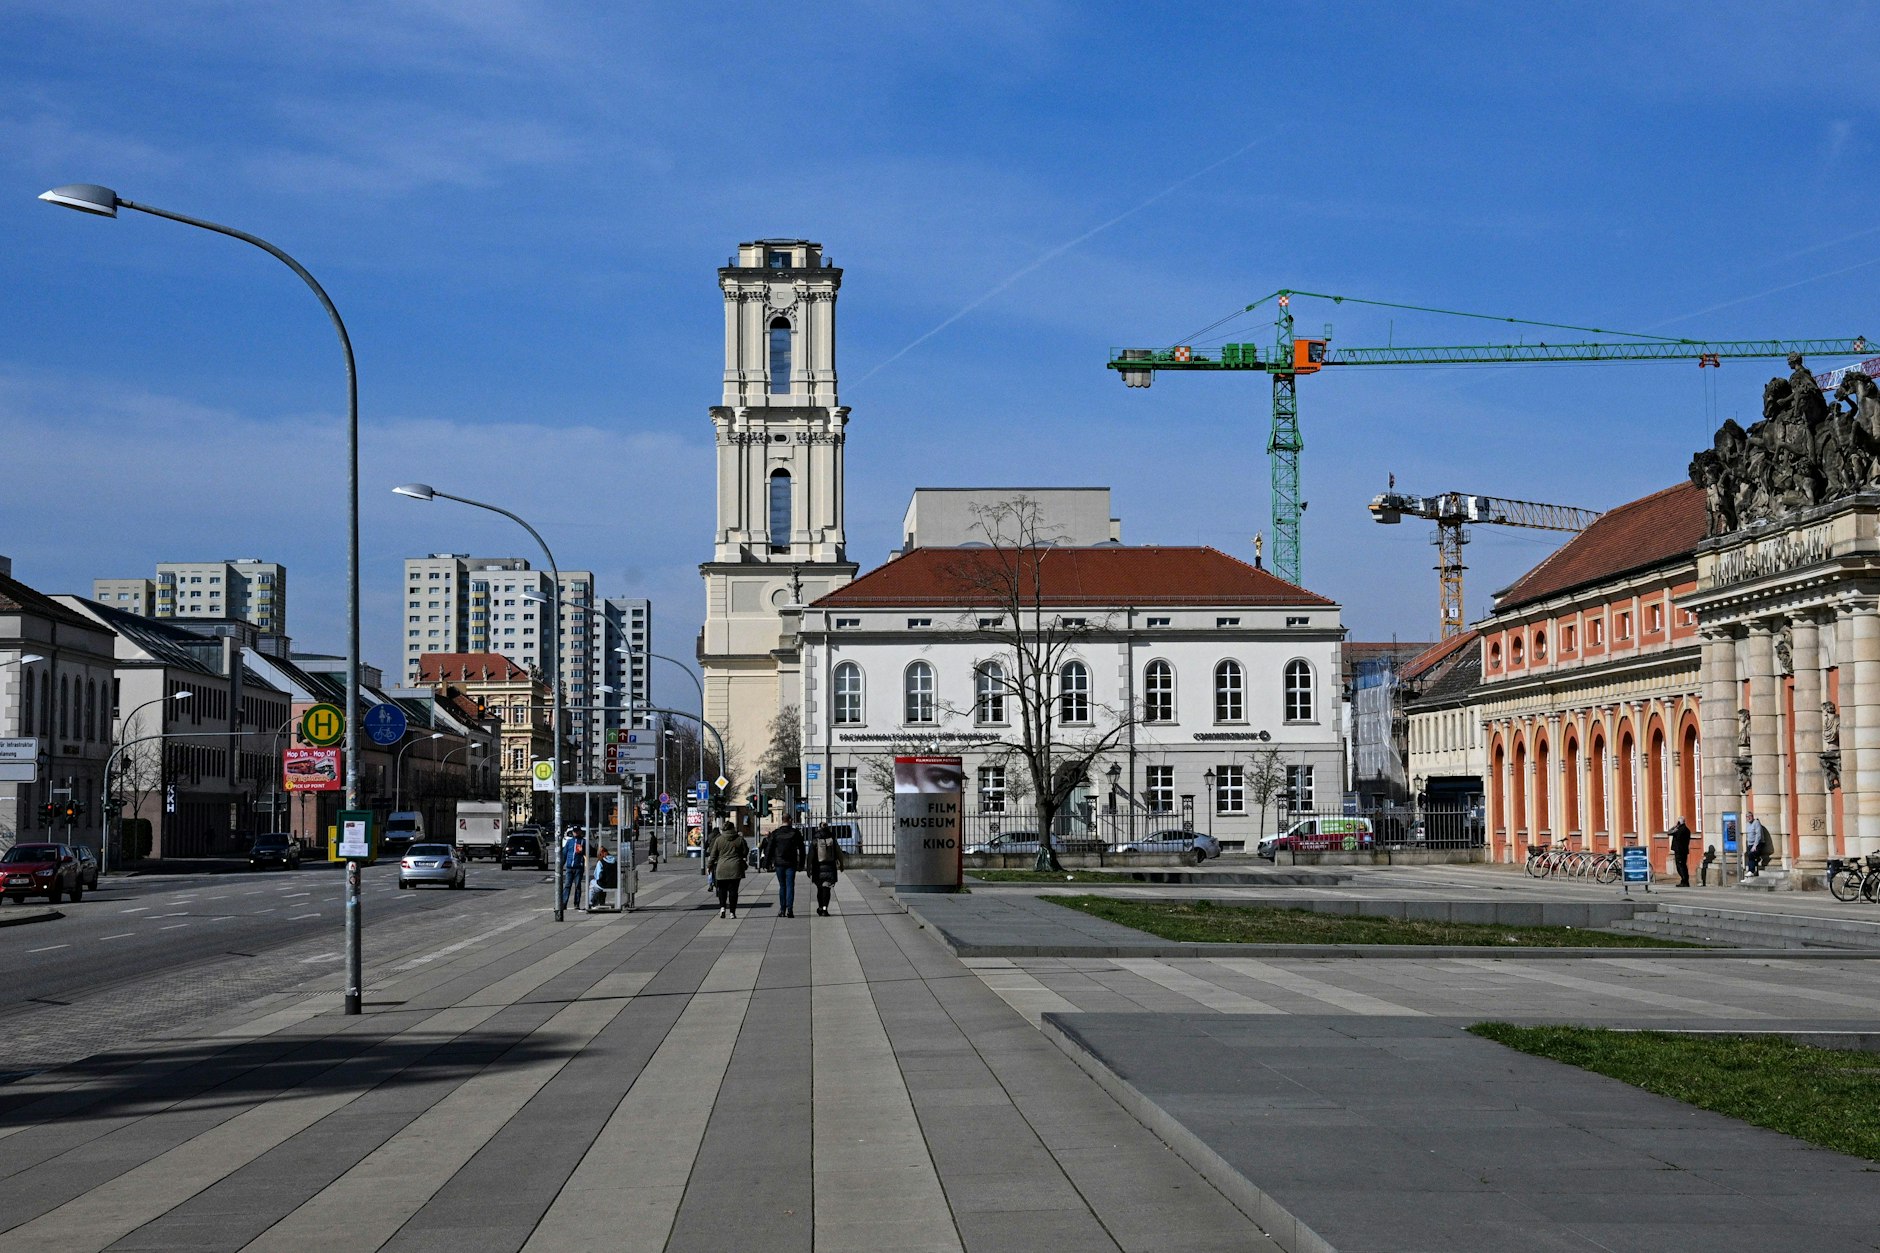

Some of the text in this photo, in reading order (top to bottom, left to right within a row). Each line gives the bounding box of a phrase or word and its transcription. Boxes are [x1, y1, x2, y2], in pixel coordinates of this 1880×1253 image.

[1452, 608, 1456, 617] 1
[315, 714, 331, 736] H
[540, 766, 547, 776] H
[167, 785, 175, 813] KKH
[928, 803, 956, 813] FILM
[900, 818, 955, 828] MUSEUM
[923, 839, 955, 849] KINO
